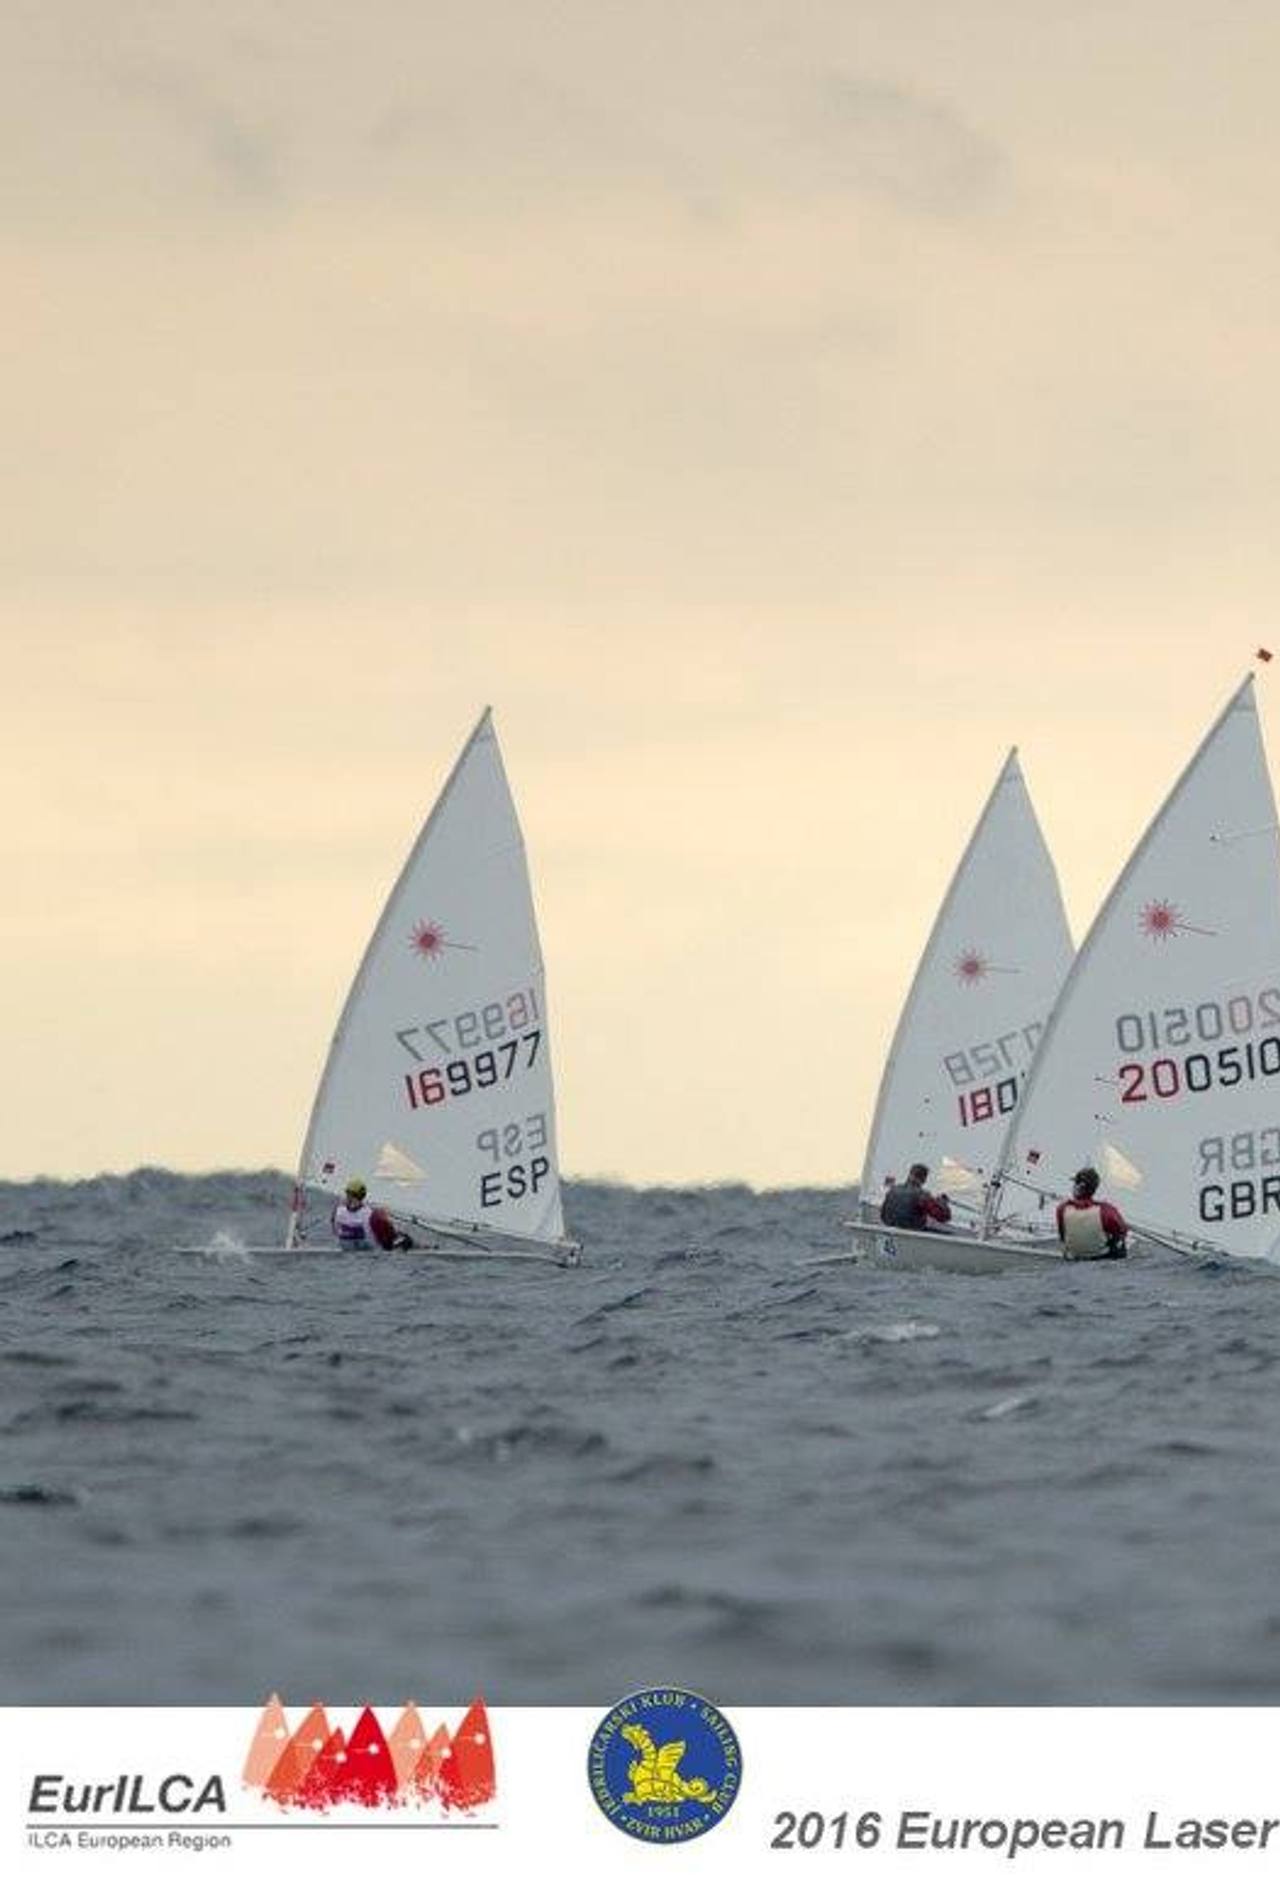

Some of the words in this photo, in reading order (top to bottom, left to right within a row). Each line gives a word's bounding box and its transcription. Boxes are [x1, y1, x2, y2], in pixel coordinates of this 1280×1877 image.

[404, 1031, 541, 1109] 169977
[959, 1077, 1019, 1127] 180
[480, 1156, 549, 1208] ESP
